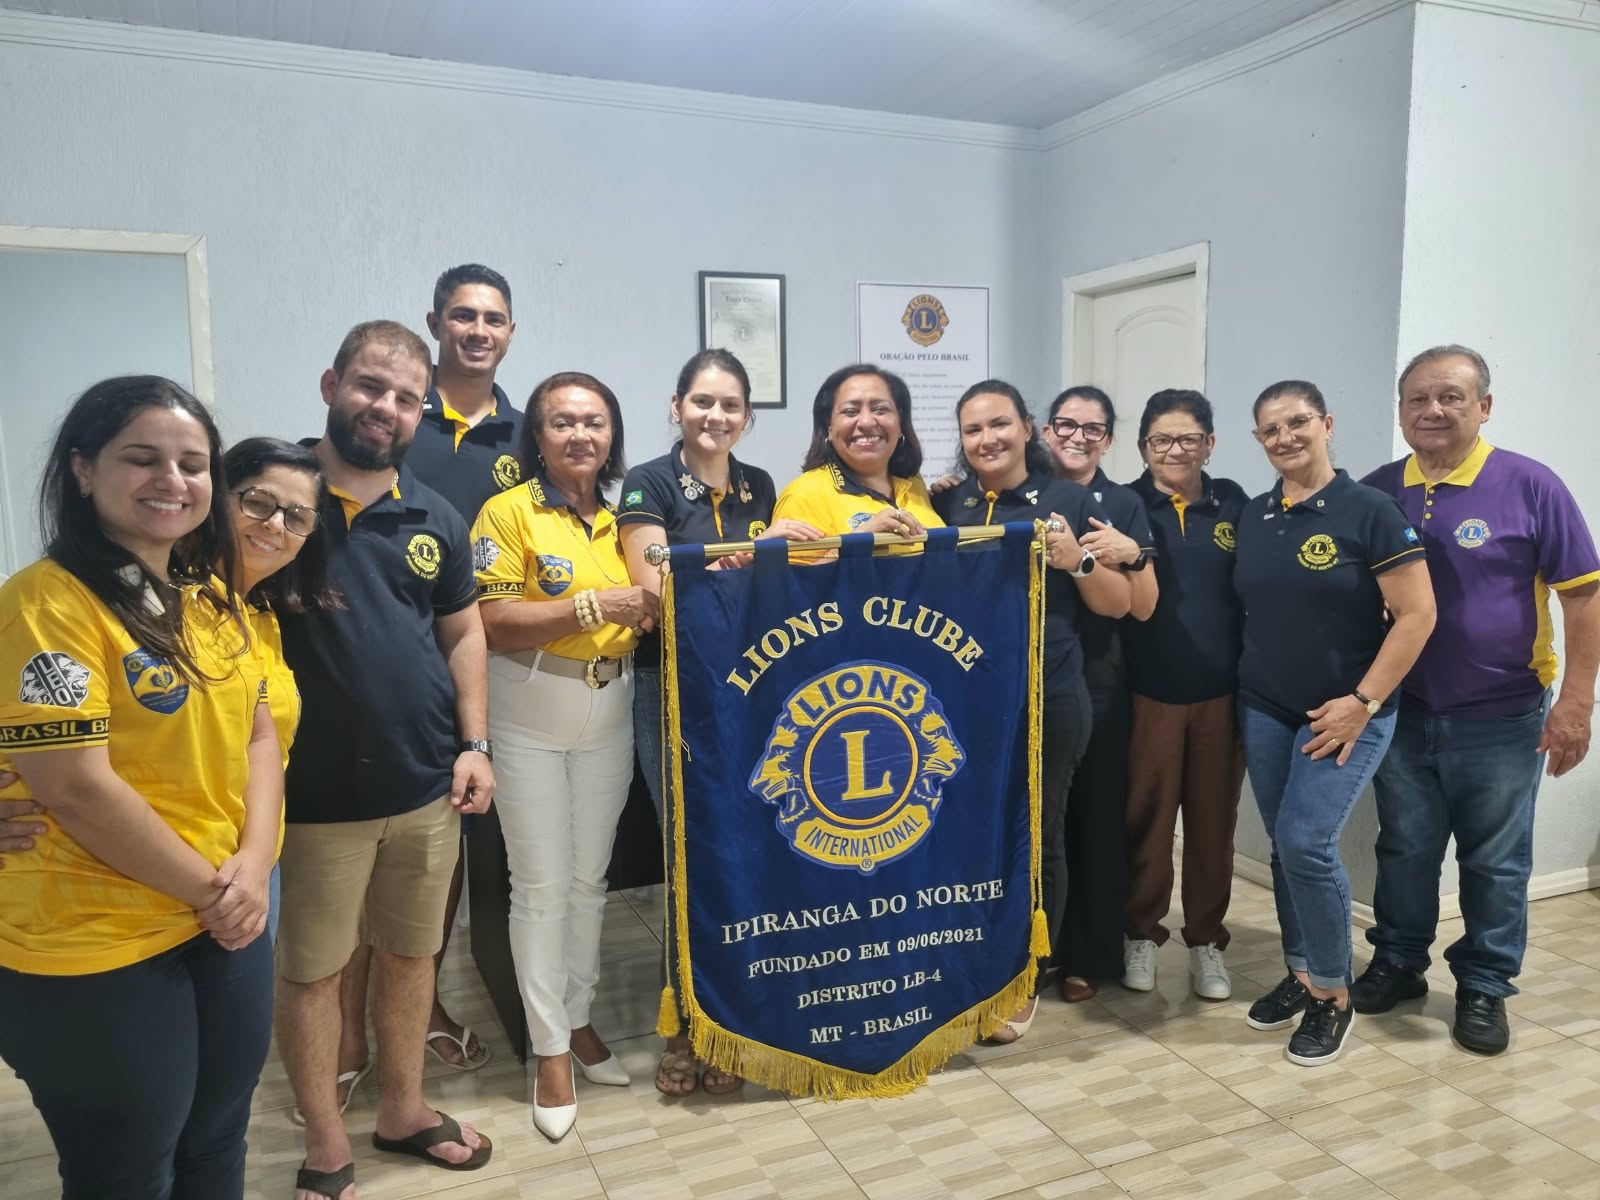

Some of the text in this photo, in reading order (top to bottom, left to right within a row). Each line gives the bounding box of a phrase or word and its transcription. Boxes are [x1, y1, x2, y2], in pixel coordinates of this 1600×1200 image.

[911, 296, 941, 309] LIONS
[919, 310, 933, 329] L
[880, 352, 969, 361] ORAÇÃO PELO BRASIL
[530, 477, 546, 502] RASIL
[831, 464, 846, 487] RASIL
[422, 544, 432, 560] L
[1314, 542, 1324, 554] L
[1467, 527, 1478, 539] L
[726, 596, 985, 696] LIONS CLUBE
[37, 658, 72, 705] LEO
[795, 669, 921, 723] LIONS
[840, 729, 894, 801] L
[803, 814, 924, 858] INTERNATIONAL
[721, 879, 1004, 944] IPIRANGA DO NORTE
[747, 927, 984, 979] FUNDADO EM 09/06/2021
[798, 968, 942, 1009] DISTRITO LB-4
[809, 1026, 843, 1045] MT
[863, 1006, 932, 1037] BRASIL
